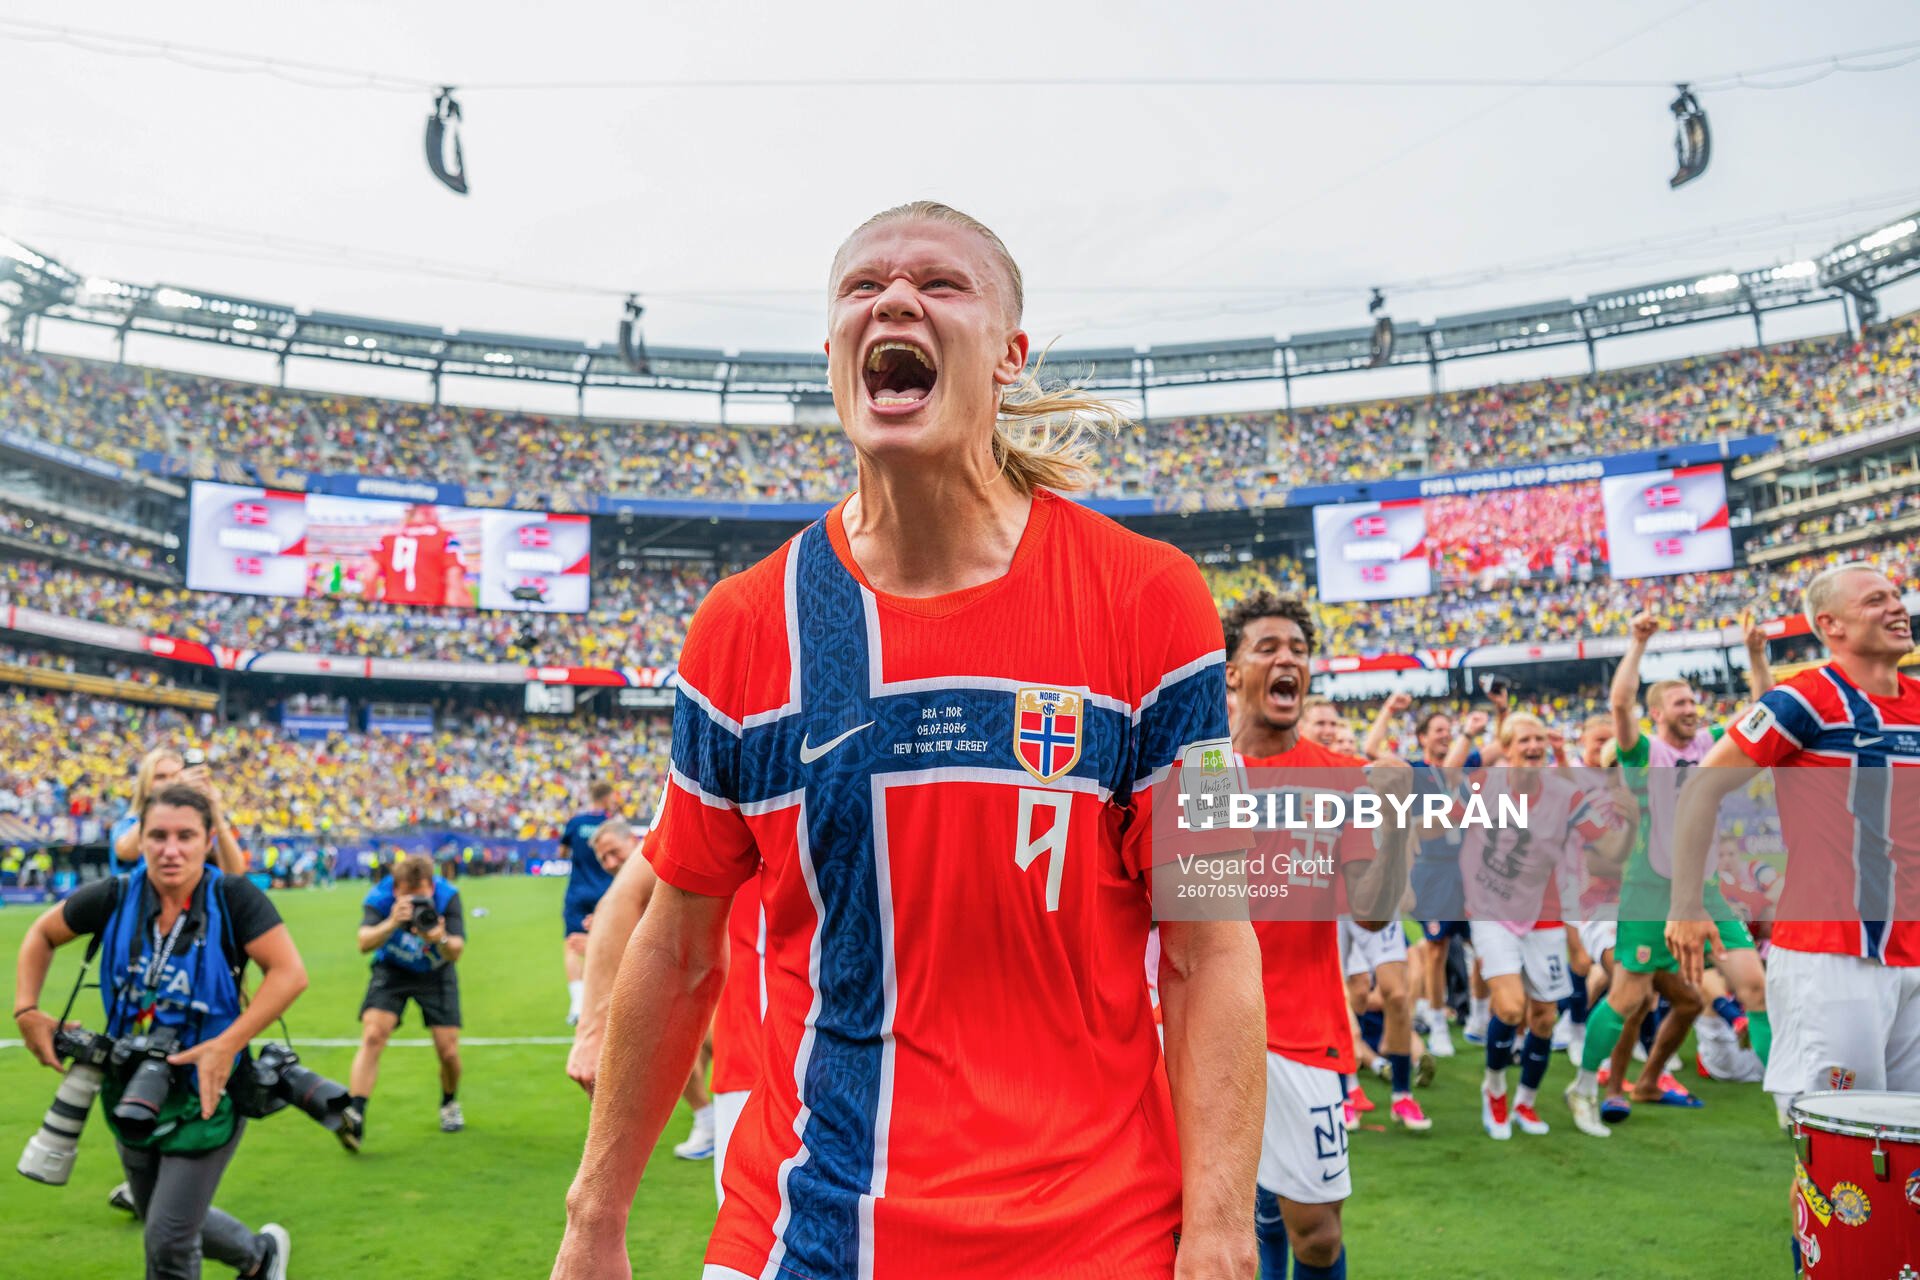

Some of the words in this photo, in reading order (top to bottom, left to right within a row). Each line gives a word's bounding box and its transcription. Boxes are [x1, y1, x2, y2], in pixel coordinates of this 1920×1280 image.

[1454, 471, 1513, 491] WORLD
[1513, 467, 1545, 486] CUP
[1040, 691, 1061, 702] NORGE
[922, 708, 937, 719] BRA
[945, 706, 963, 718] NOR
[917, 723, 967, 735] 05.07.2026
[893, 743, 912, 754] NEW
[914, 741, 934, 753] YORK
[935, 740, 953, 751] NEW
[954, 740, 988, 752] JERSEY
[1014, 787, 1073, 912] 9
